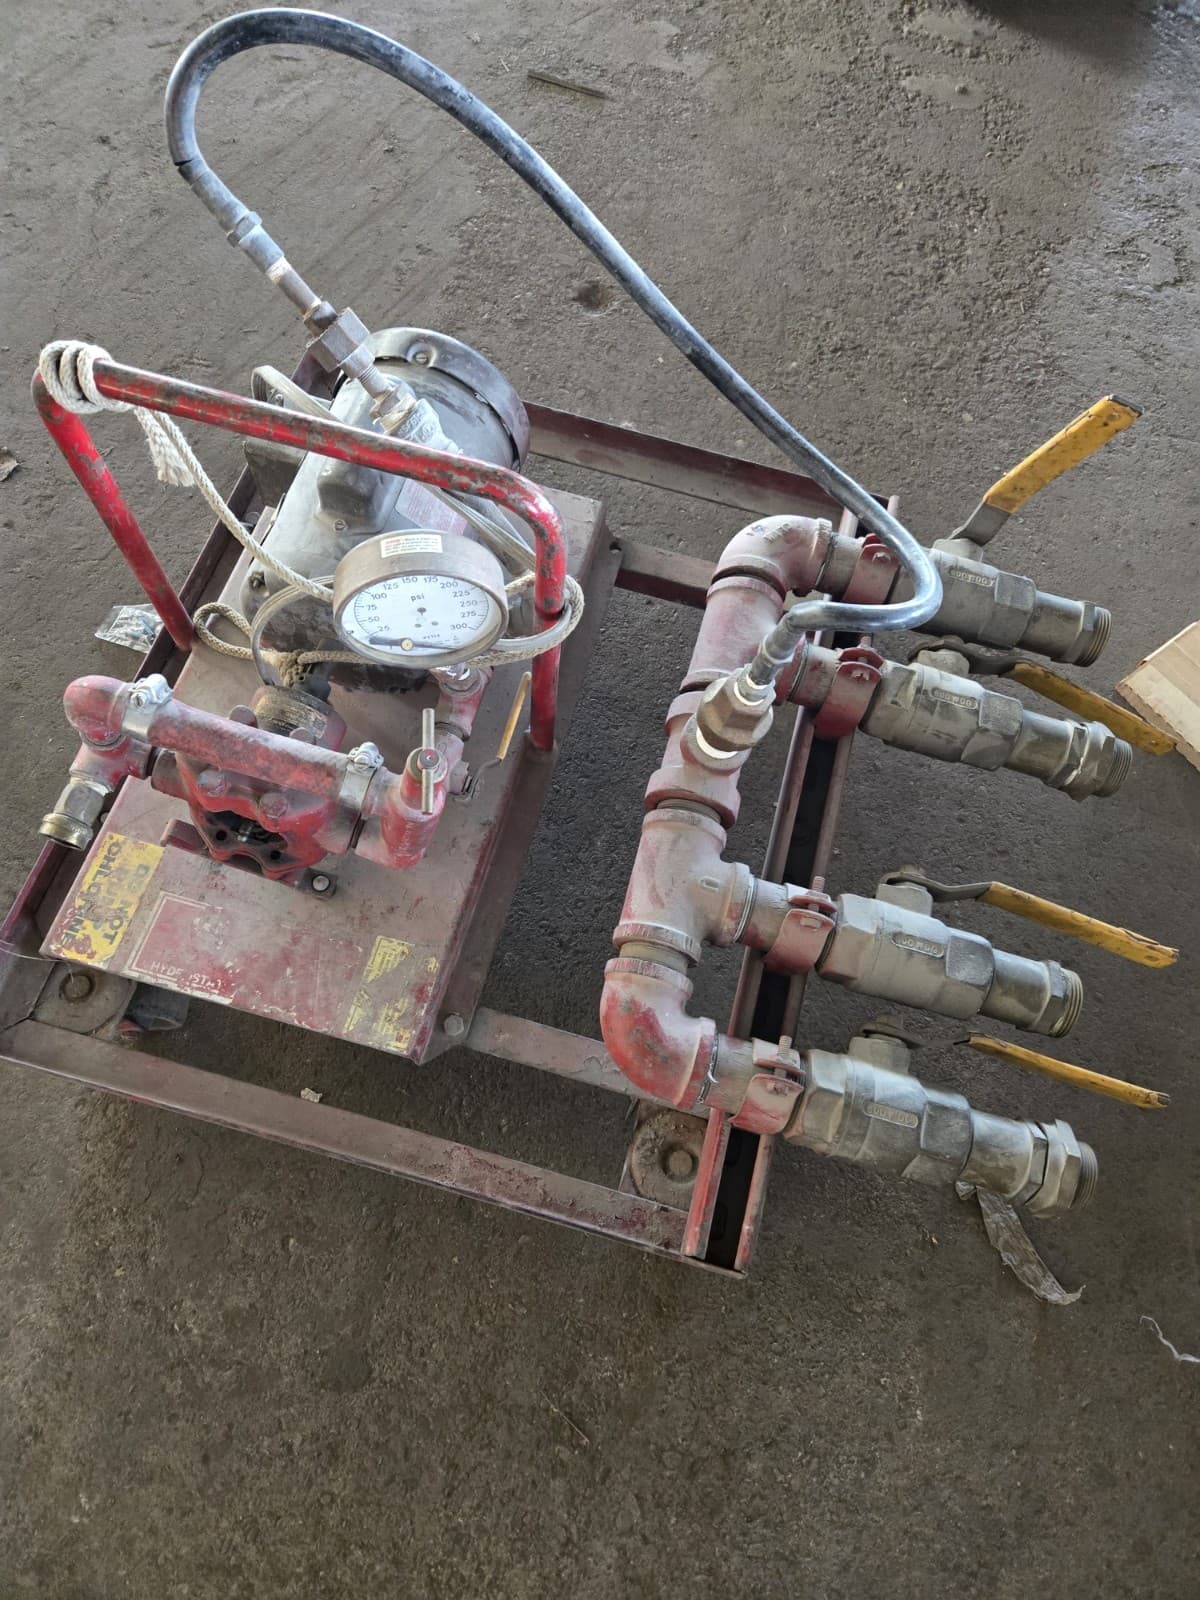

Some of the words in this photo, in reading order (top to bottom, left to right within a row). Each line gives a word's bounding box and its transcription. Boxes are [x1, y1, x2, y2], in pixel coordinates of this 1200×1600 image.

[401, 576, 418, 584] 150
[383, 582, 399, 590] 125
[440, 581, 459, 589] 200
[371, 592, 388, 600] 100
[411, 593, 425, 602] psi
[452, 590, 471, 598] 225
